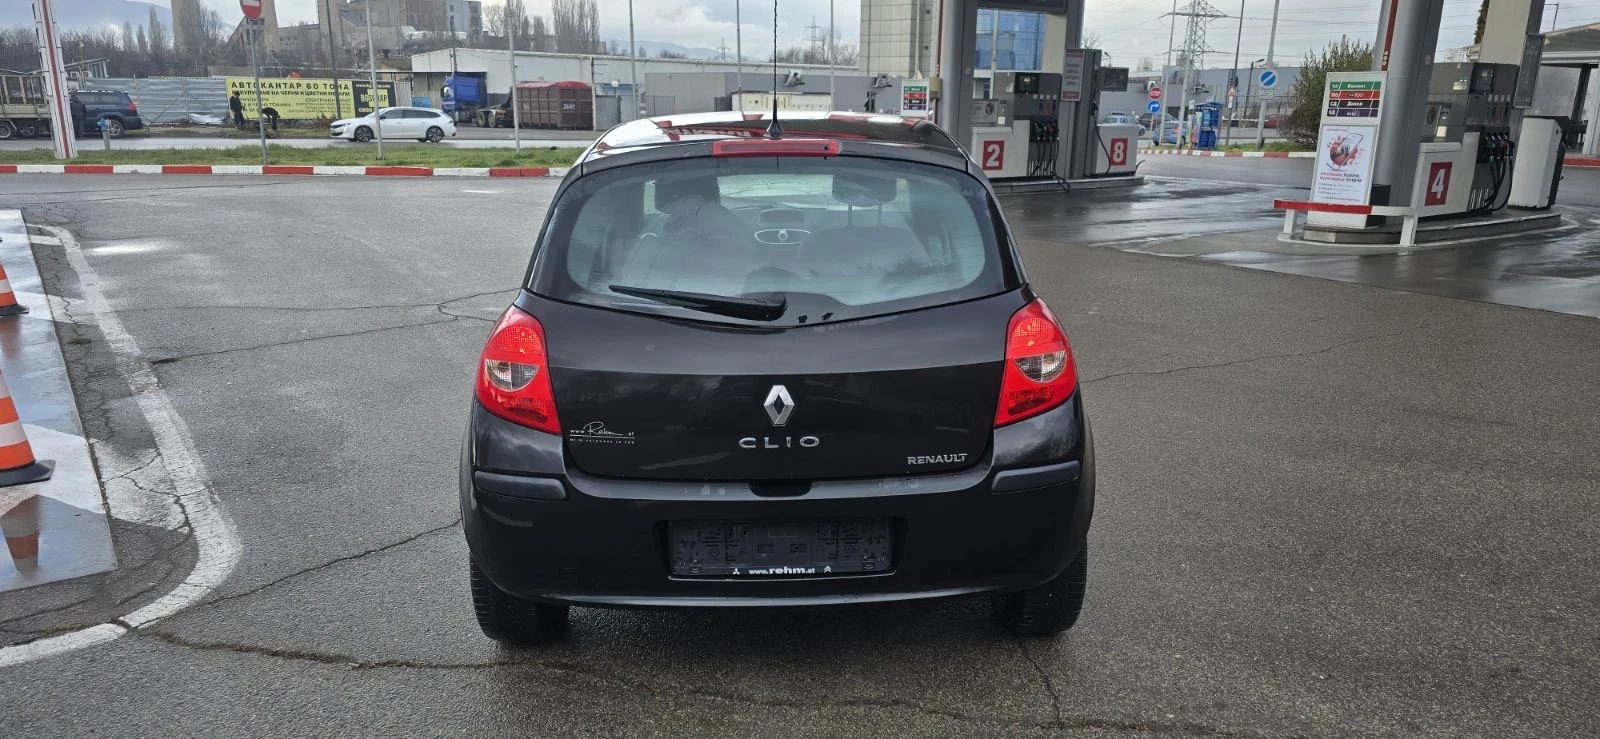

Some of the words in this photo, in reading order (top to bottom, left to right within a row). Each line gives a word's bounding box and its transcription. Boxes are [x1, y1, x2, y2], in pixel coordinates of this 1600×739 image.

[985, 143, 1001, 167] 2
[1112, 141, 1125, 162] 8
[1431, 168, 1446, 199] 4
[738, 435, 820, 449] CLIO
[906, 453, 968, 466] RENAULT
[748, 566, 816, 575] www.rehm.at
